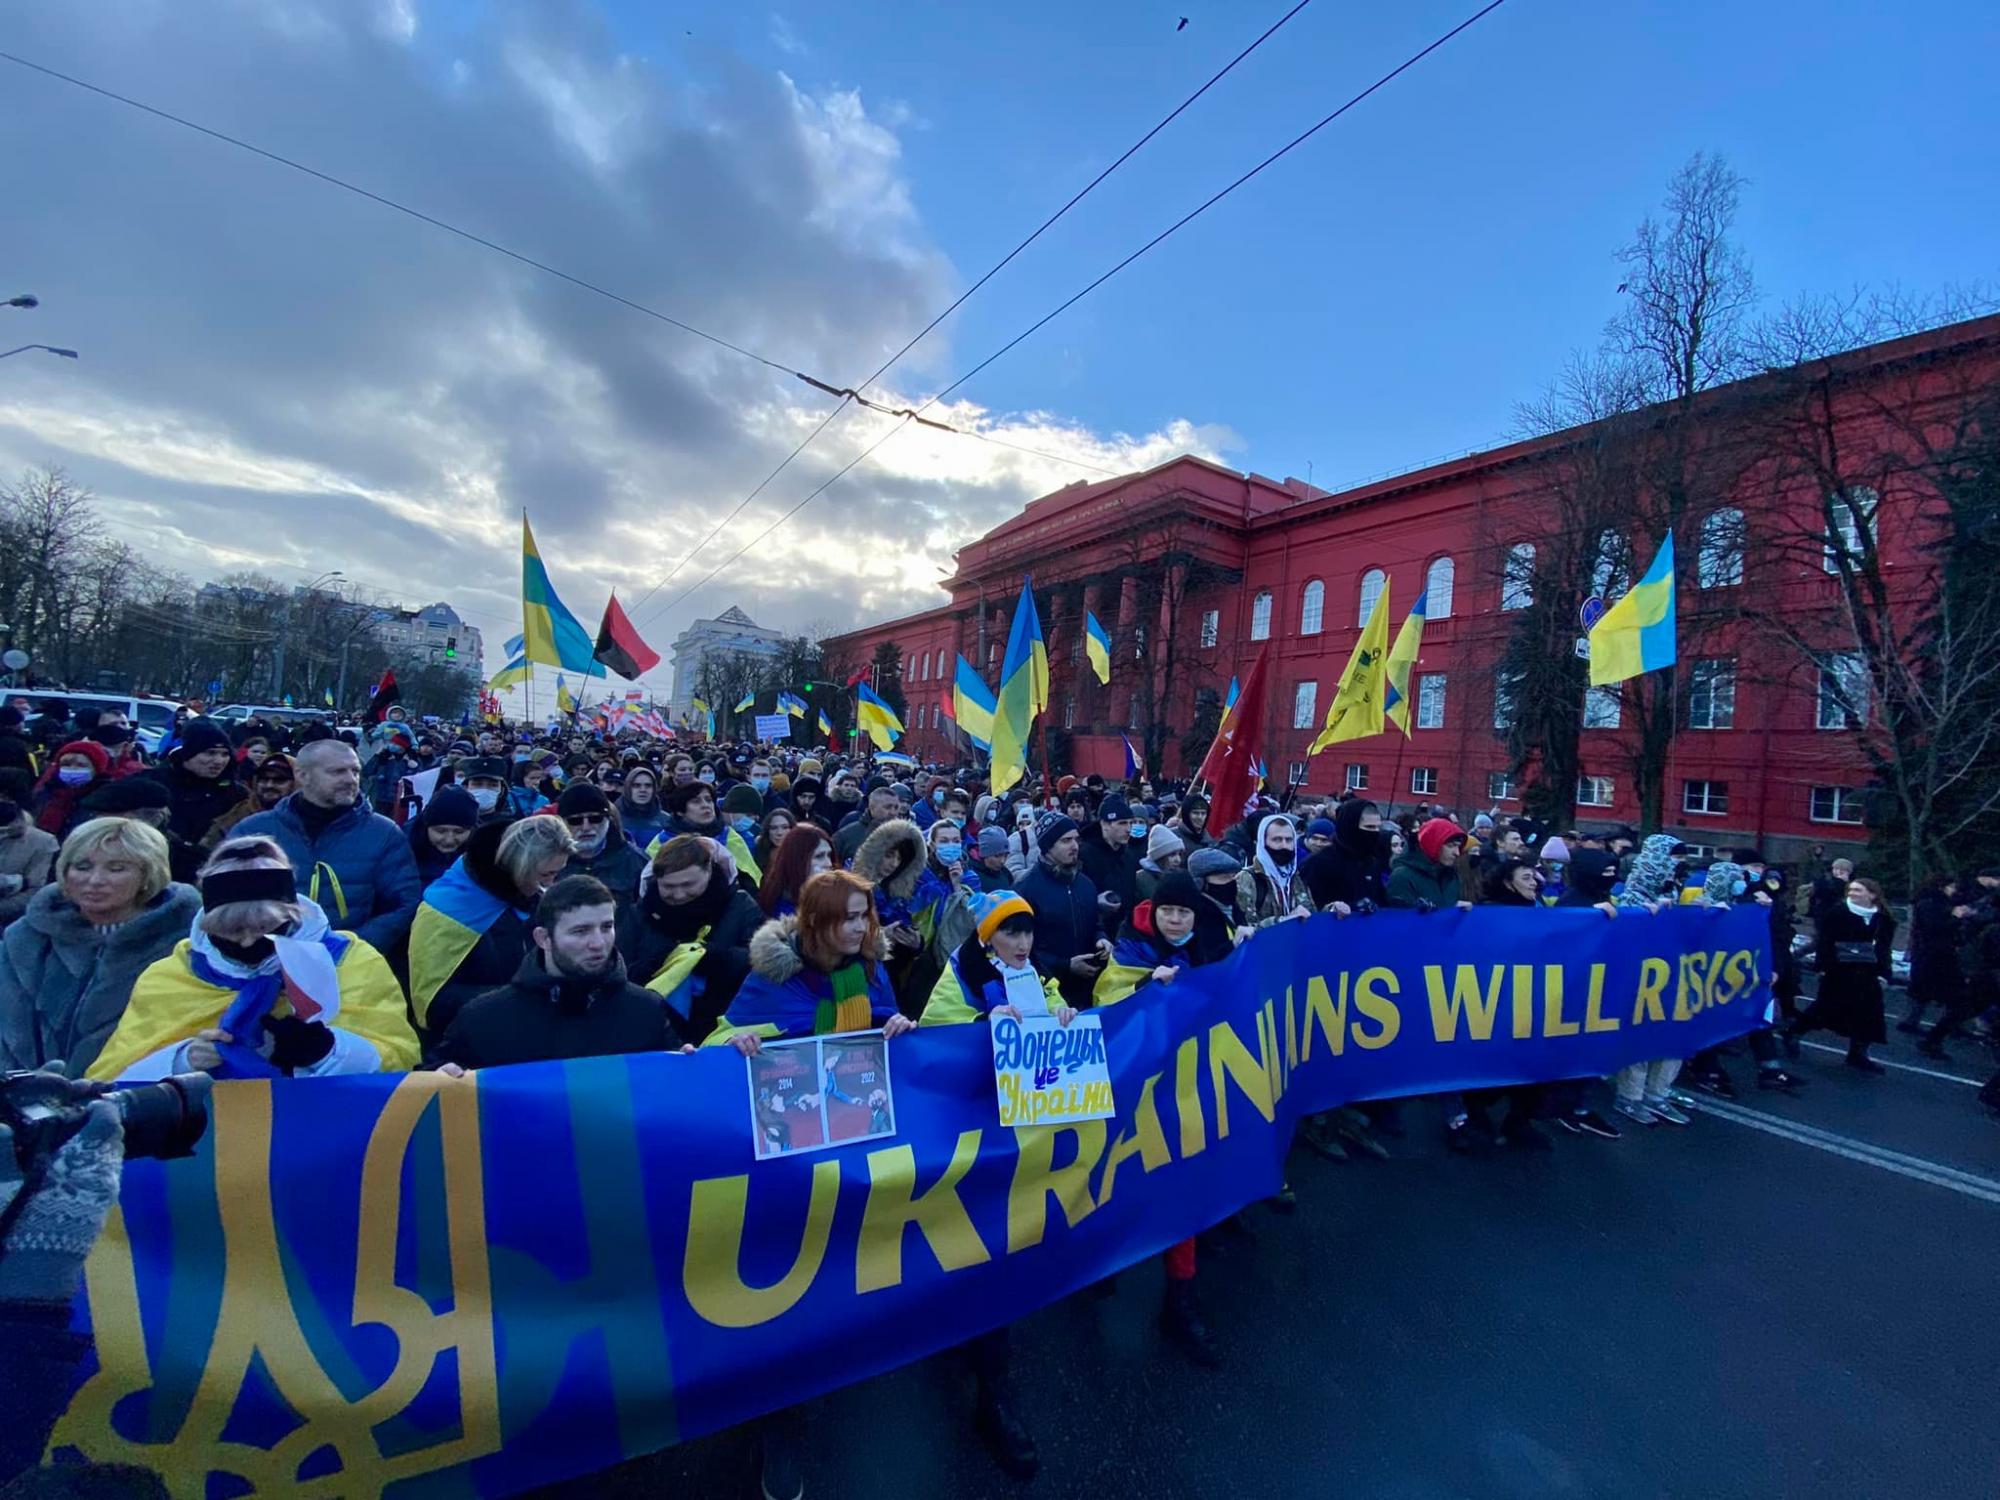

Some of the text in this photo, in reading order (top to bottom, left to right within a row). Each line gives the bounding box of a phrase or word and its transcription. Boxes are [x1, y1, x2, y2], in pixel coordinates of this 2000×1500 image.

[1423, 963, 1620, 1042] WILL
[994, 1017, 1106, 1075] Донецьк
[778, 1077, 794, 1091] 2014
[860, 1071, 876, 1084] 2022
[1034, 1066, 1060, 1091] це
[998, 1072, 1114, 1126] Україна
